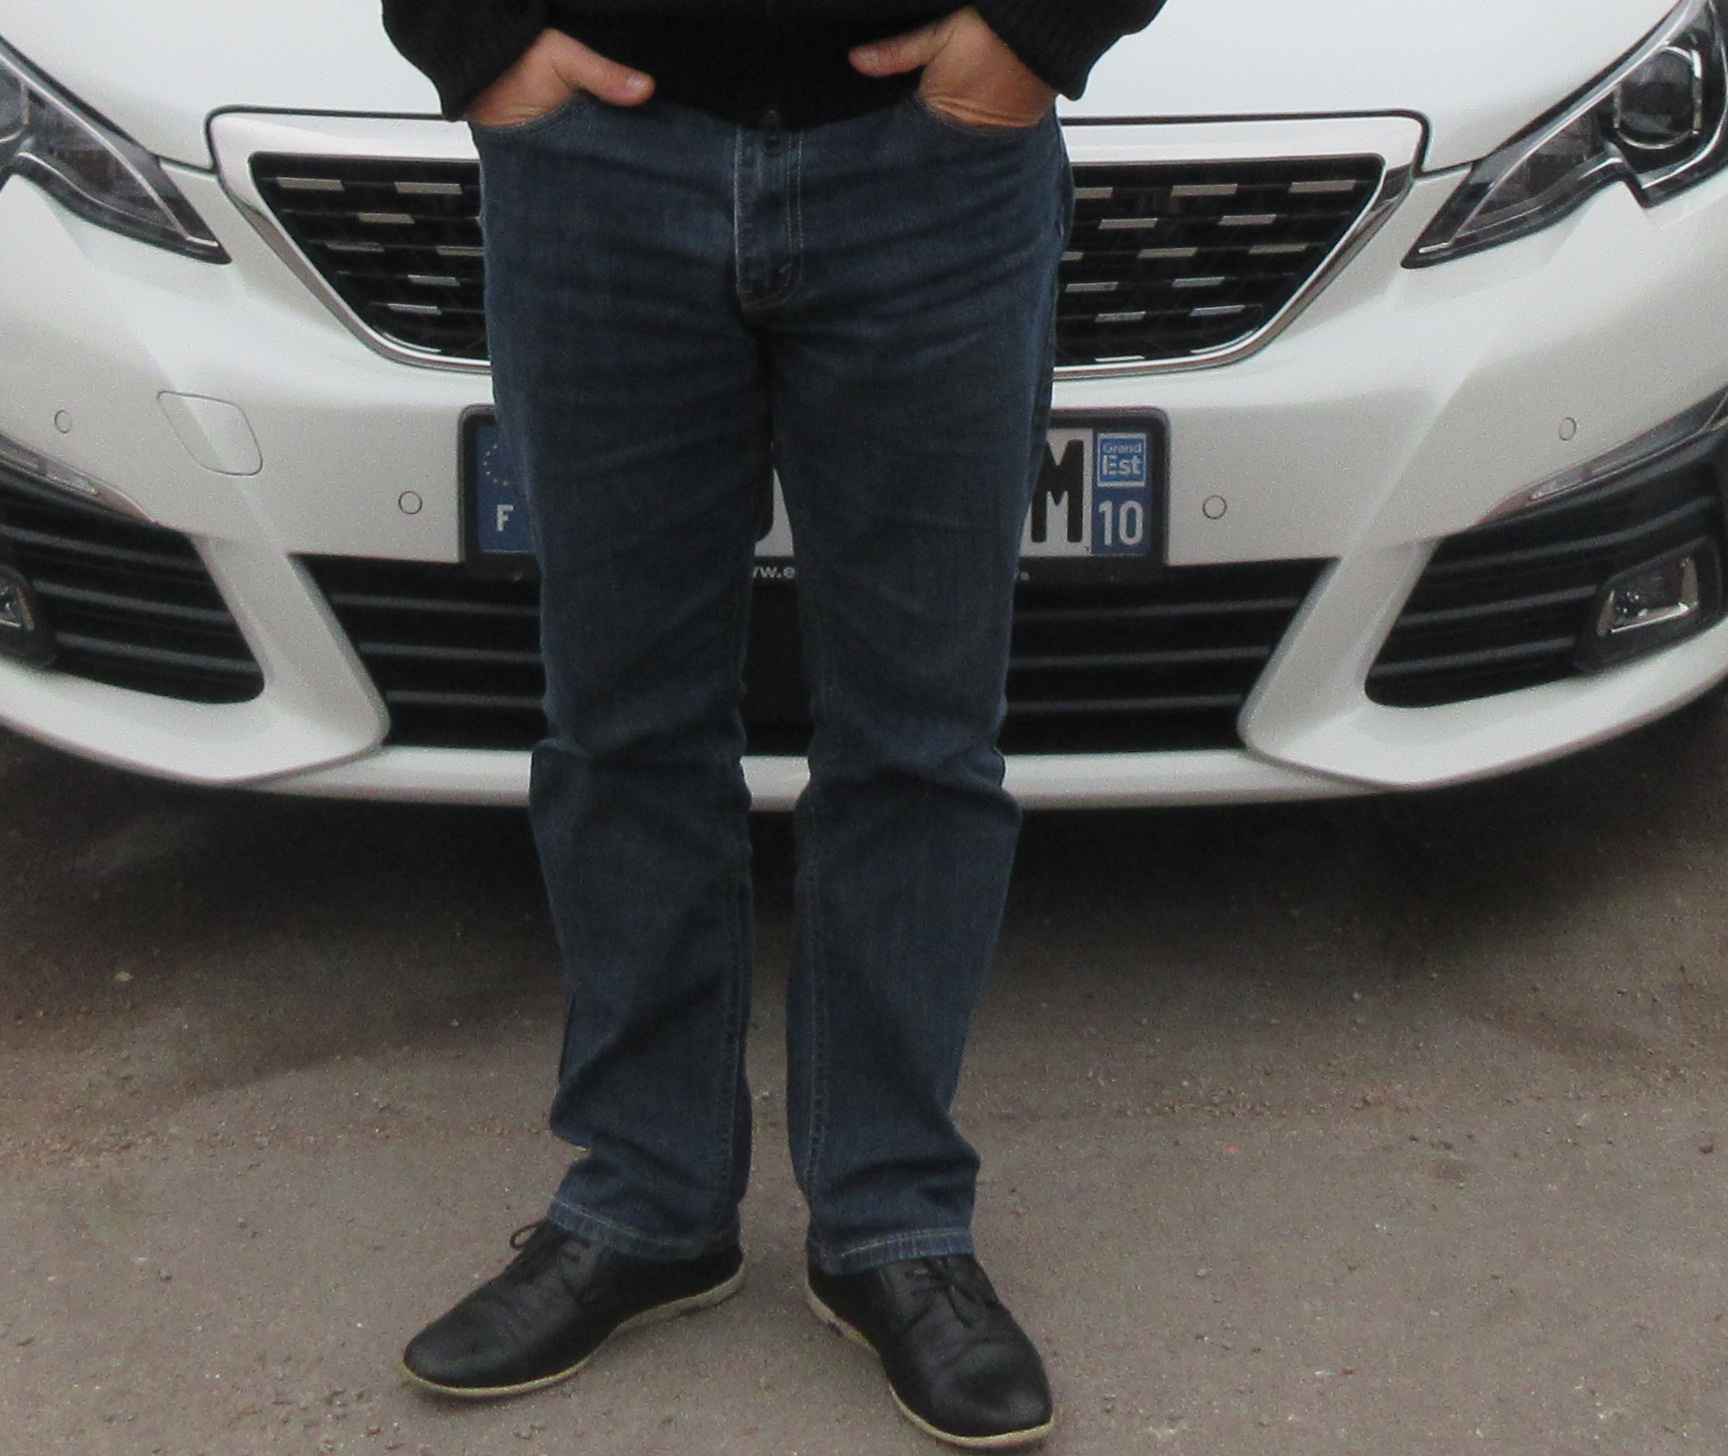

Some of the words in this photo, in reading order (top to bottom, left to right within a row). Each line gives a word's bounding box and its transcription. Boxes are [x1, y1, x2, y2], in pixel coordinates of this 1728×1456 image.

[1102, 443, 1143, 454] Grand
[1101, 455, 1143, 476] Est
[1030, 439, 1084, 543] M
[496, 504, 514, 532] F
[1098, 500, 1144, 546] 10
